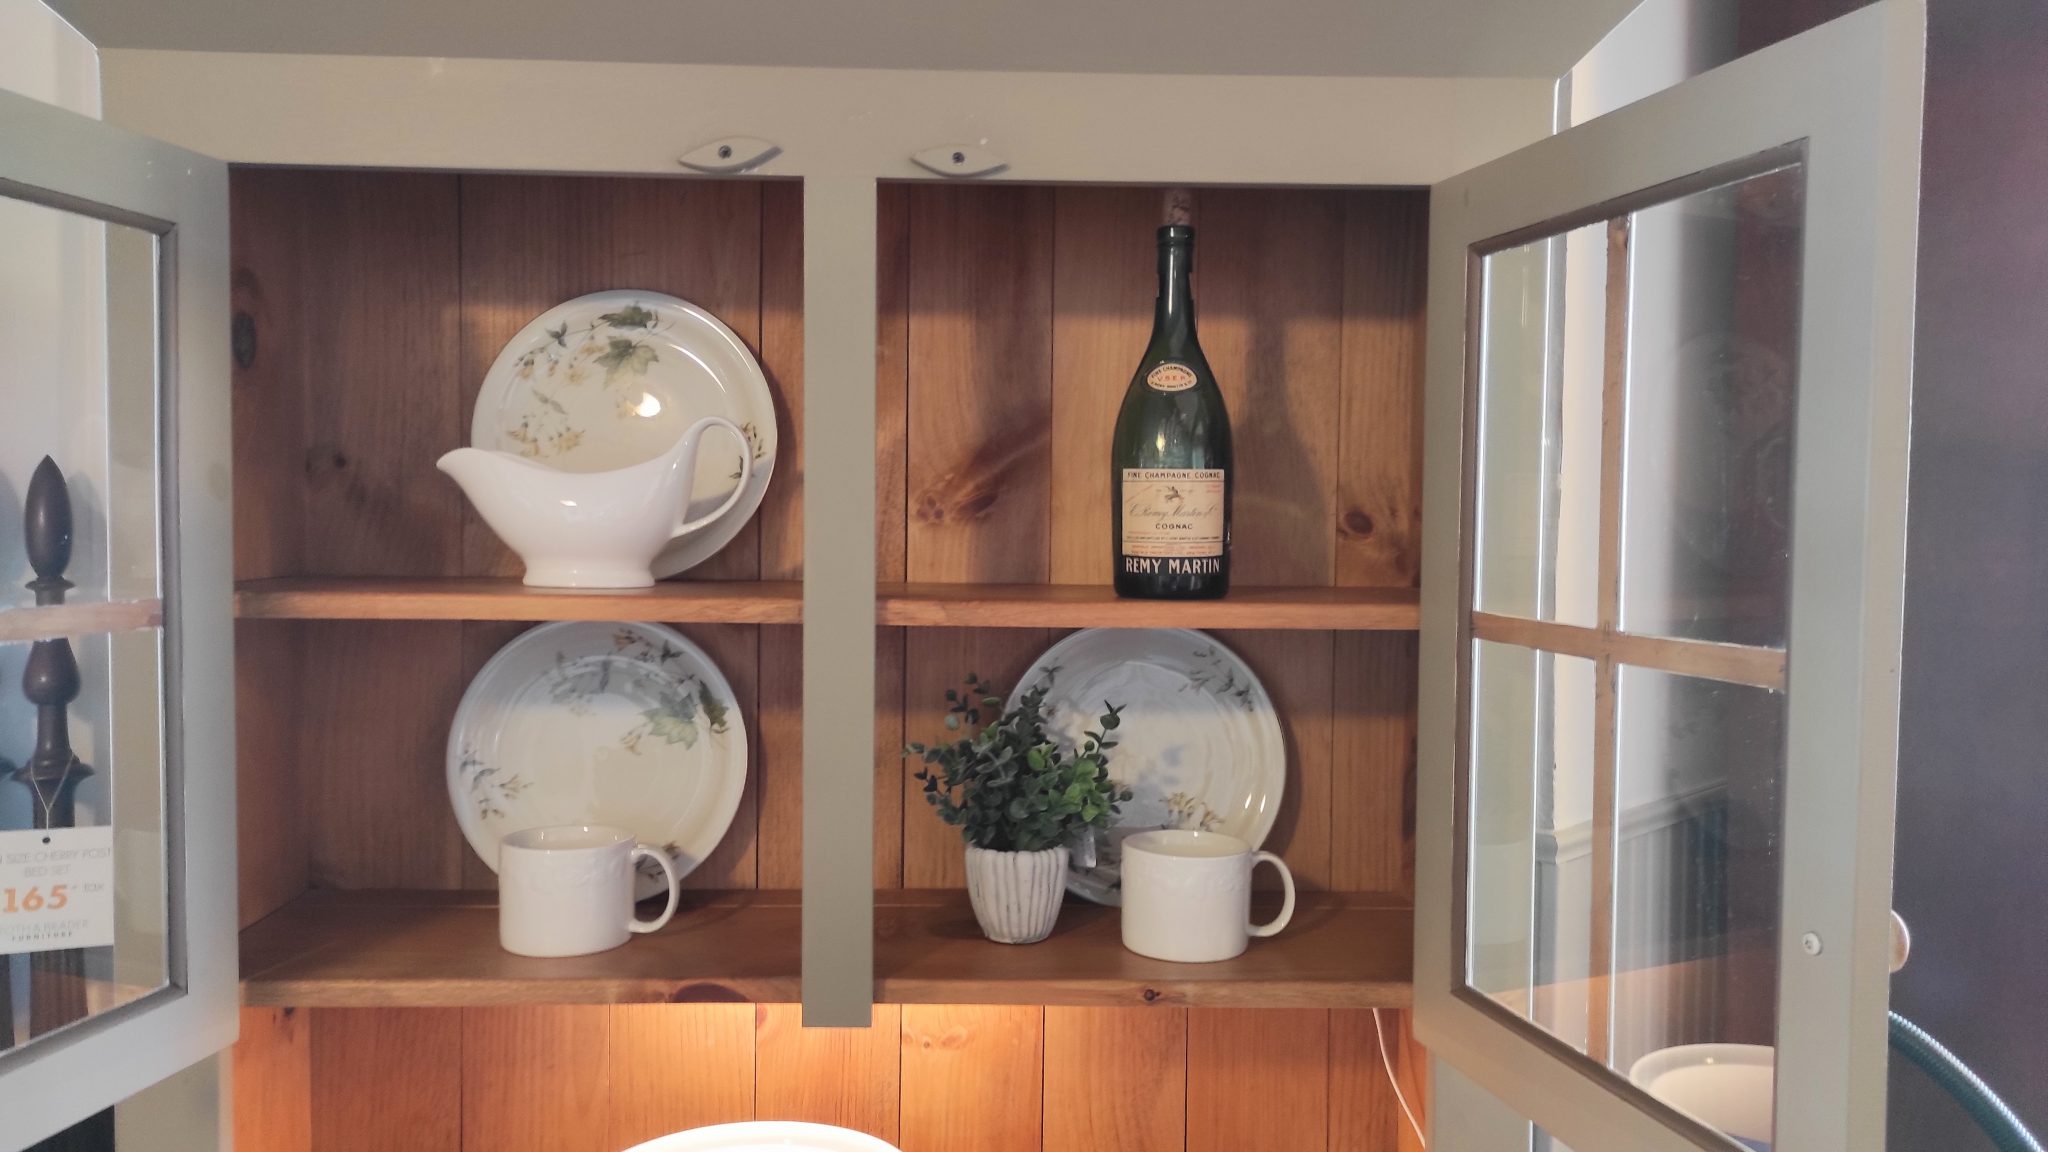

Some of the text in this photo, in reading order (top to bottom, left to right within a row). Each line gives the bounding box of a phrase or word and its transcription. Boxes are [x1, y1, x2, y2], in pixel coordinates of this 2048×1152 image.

[1126, 557, 1220, 574] REMY MARTIN
[34, 849, 80, 863] CHERRY
[24, 864, 71, 878] BED SET
[3, 884, 68, 913] 165
[12, 931, 73, 941] FURNITURE
